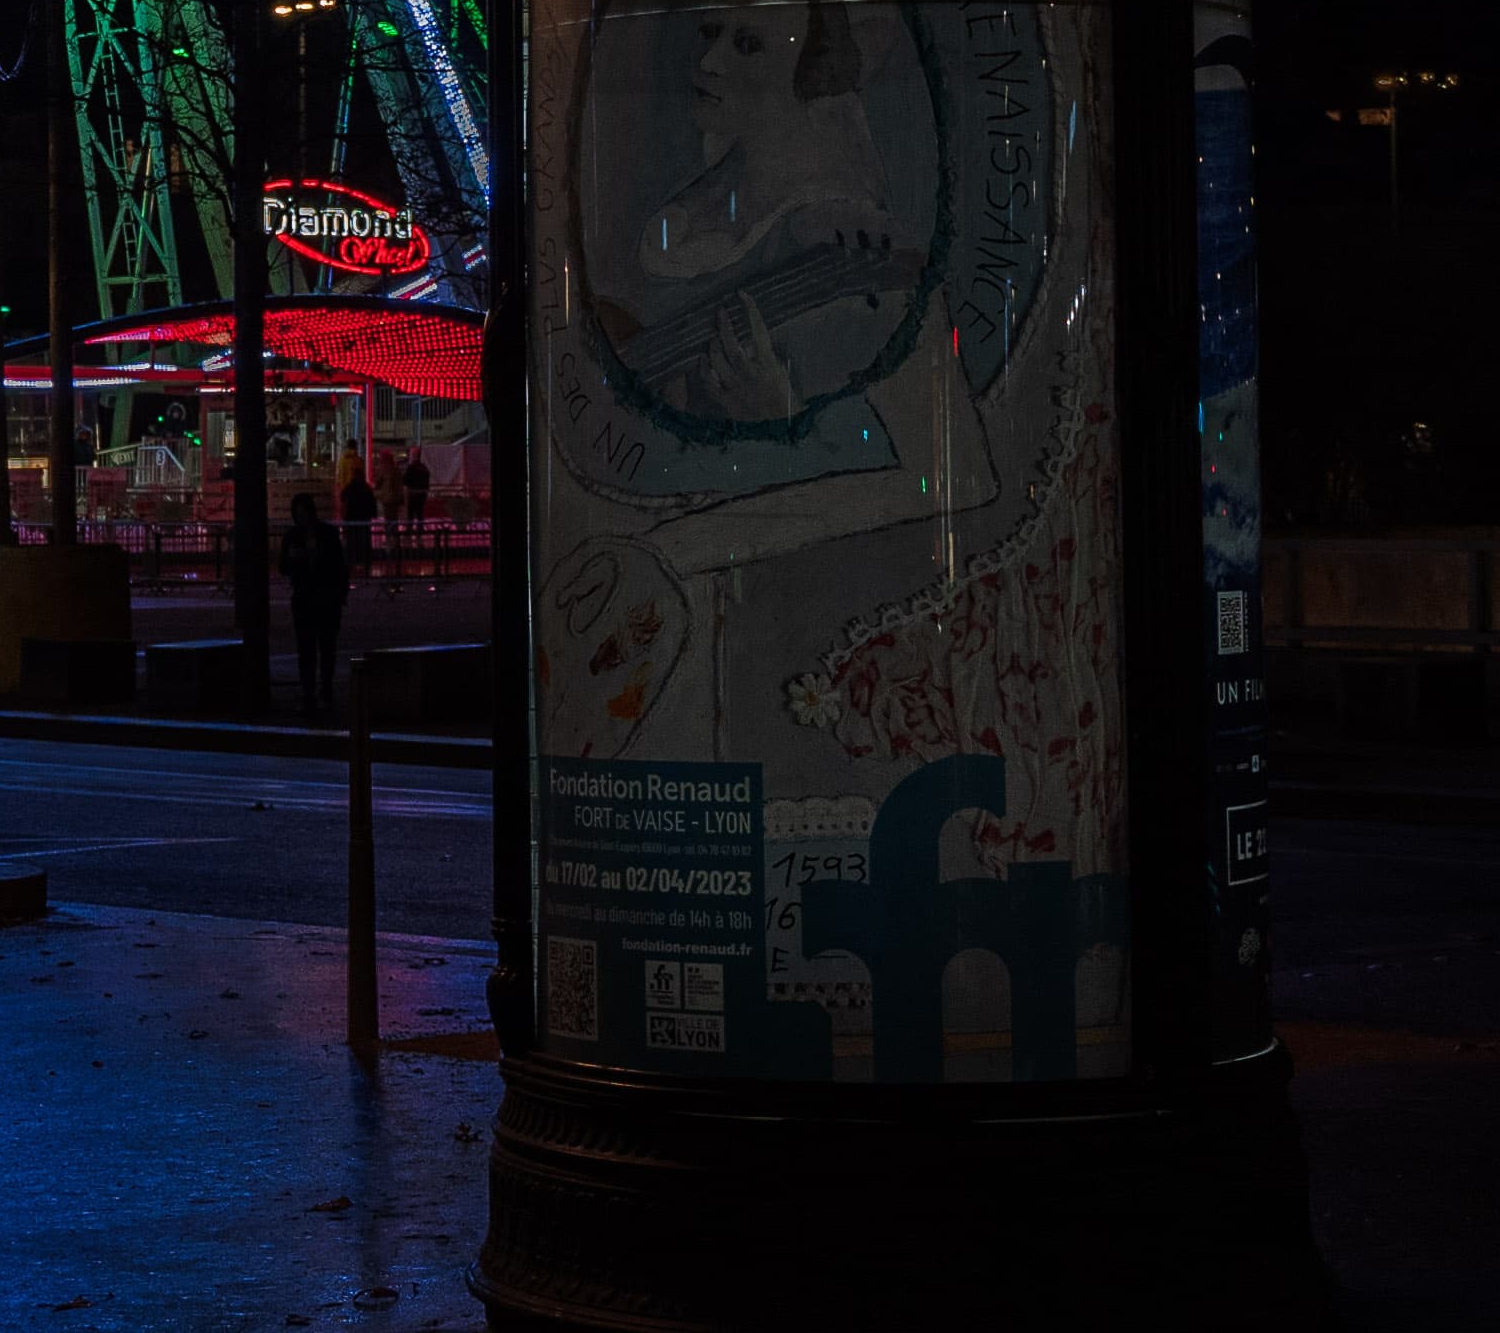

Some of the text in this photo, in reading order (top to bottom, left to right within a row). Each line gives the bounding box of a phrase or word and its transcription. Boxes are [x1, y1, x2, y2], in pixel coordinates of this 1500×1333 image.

[262, 196, 413, 239] Diamond
[340, 236, 419, 267] Wheel
[1217, 681, 1239, 706] UN
[550, 768, 751, 804] Fondation Renaud
[574, 805, 613, 829] FORT
[615, 813, 630, 830] DE
[632, 809, 686, 833] VAISE
[705, 811, 751, 834] LYON
[1237, 832, 1253, 861] LE
[561, 861, 597, 888] 17/02
[601, 868, 621, 890] au
[625, 866, 752, 896] 02/04/2023
[772, 853, 866, 887] 1593
[621, 938, 753, 957] fondation-renaud.fr
[677, 1030, 720, 1048] LYON
